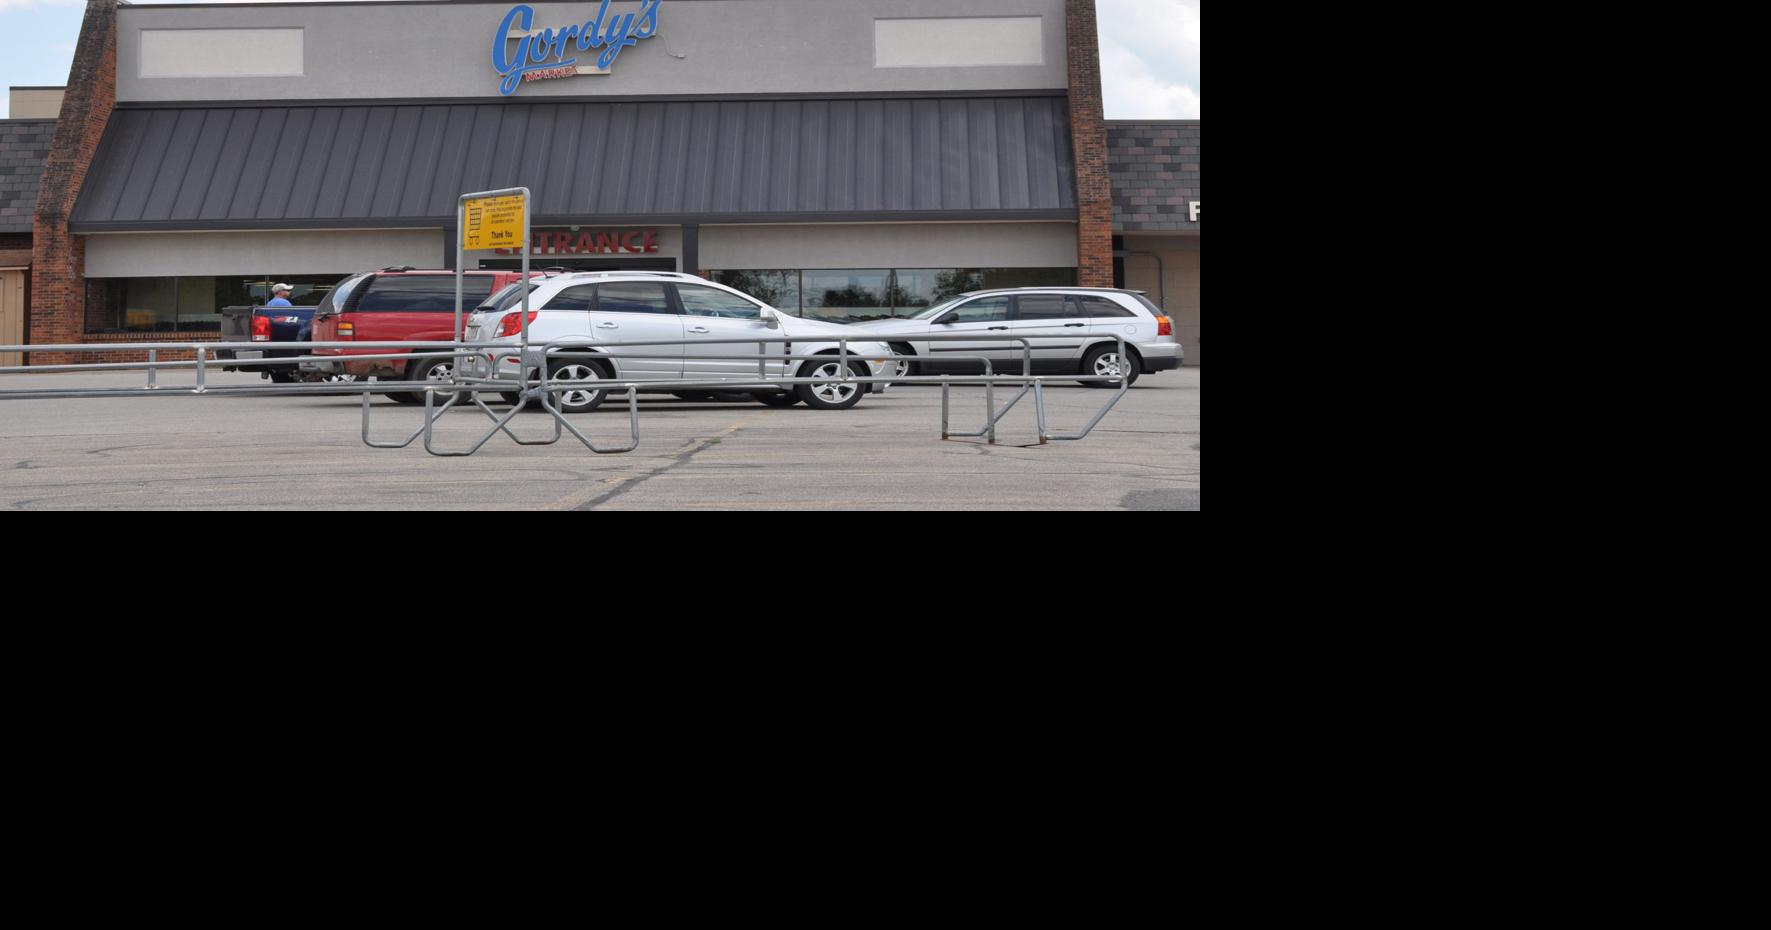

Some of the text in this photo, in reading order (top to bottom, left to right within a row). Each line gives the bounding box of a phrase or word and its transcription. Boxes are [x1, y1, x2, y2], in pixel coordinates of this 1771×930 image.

[492, 0, 661, 95] Gordy's
[525, 65, 578, 82] MARKET
[491, 231, 503, 239] Thank
[495, 231, 658, 255] TRANCE
